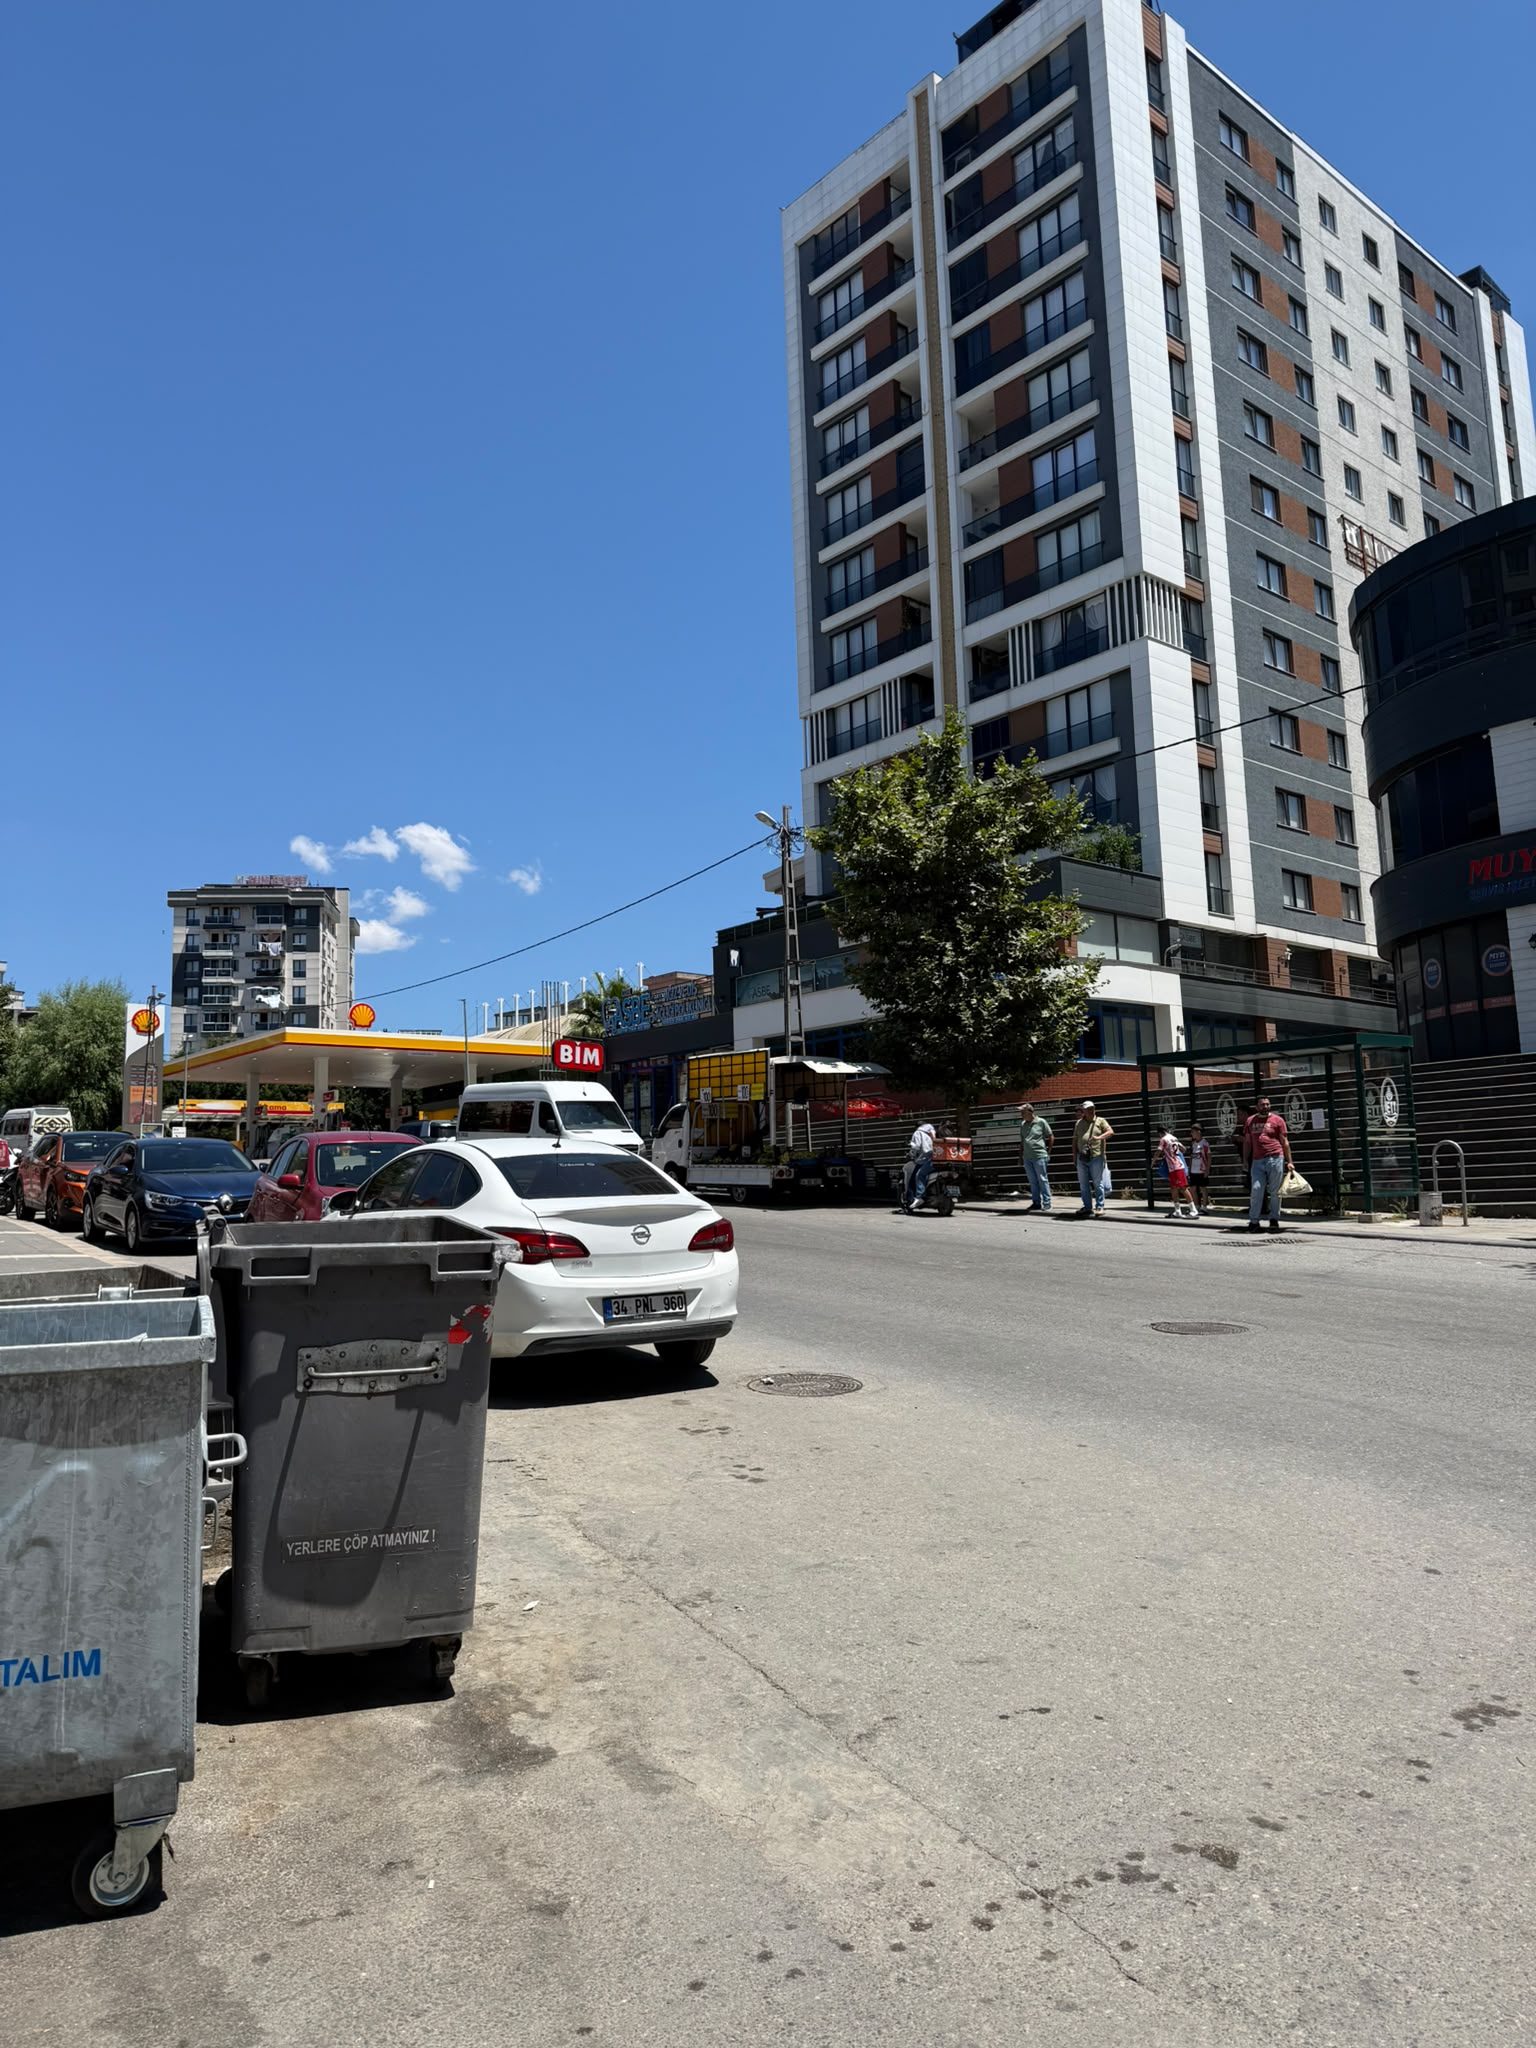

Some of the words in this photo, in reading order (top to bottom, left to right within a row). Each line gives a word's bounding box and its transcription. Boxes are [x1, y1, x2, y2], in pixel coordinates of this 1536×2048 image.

[560, 1041, 600, 1067] BİM
[613, 1301, 628, 1315] 34
[635, 1298, 656, 1314] PNL
[663, 1296, 684, 1311] 960
[286, 1538, 341, 1556] YERLERE
[343, 1533, 369, 1553] ÇÖP
[370, 1529, 430, 1549] ATMAYINIZ
[0, 1648, 101, 1687] TALIM
